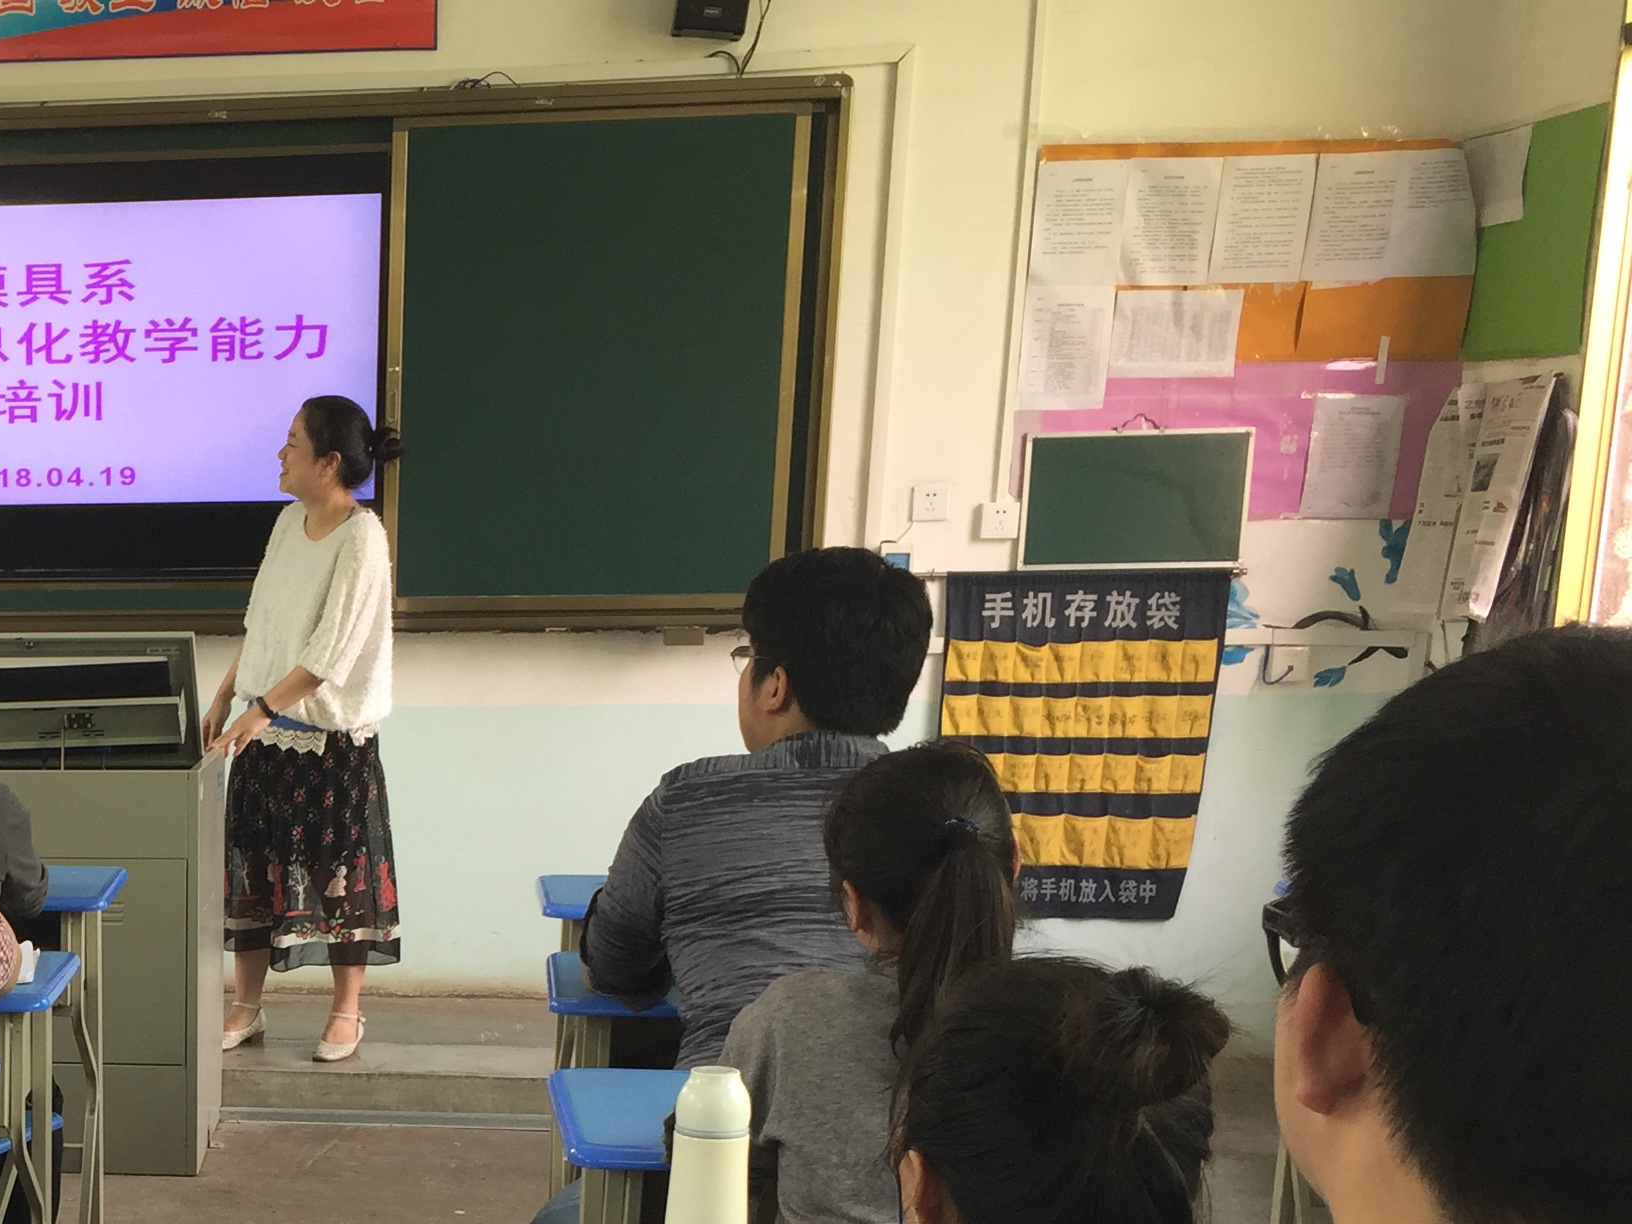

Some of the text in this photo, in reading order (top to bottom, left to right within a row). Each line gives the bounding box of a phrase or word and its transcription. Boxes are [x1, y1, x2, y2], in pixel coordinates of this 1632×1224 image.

[981, 589, 1182, 631] 手机存放袋
[1019, 876, 1158, 905] 将手机放入袋中
